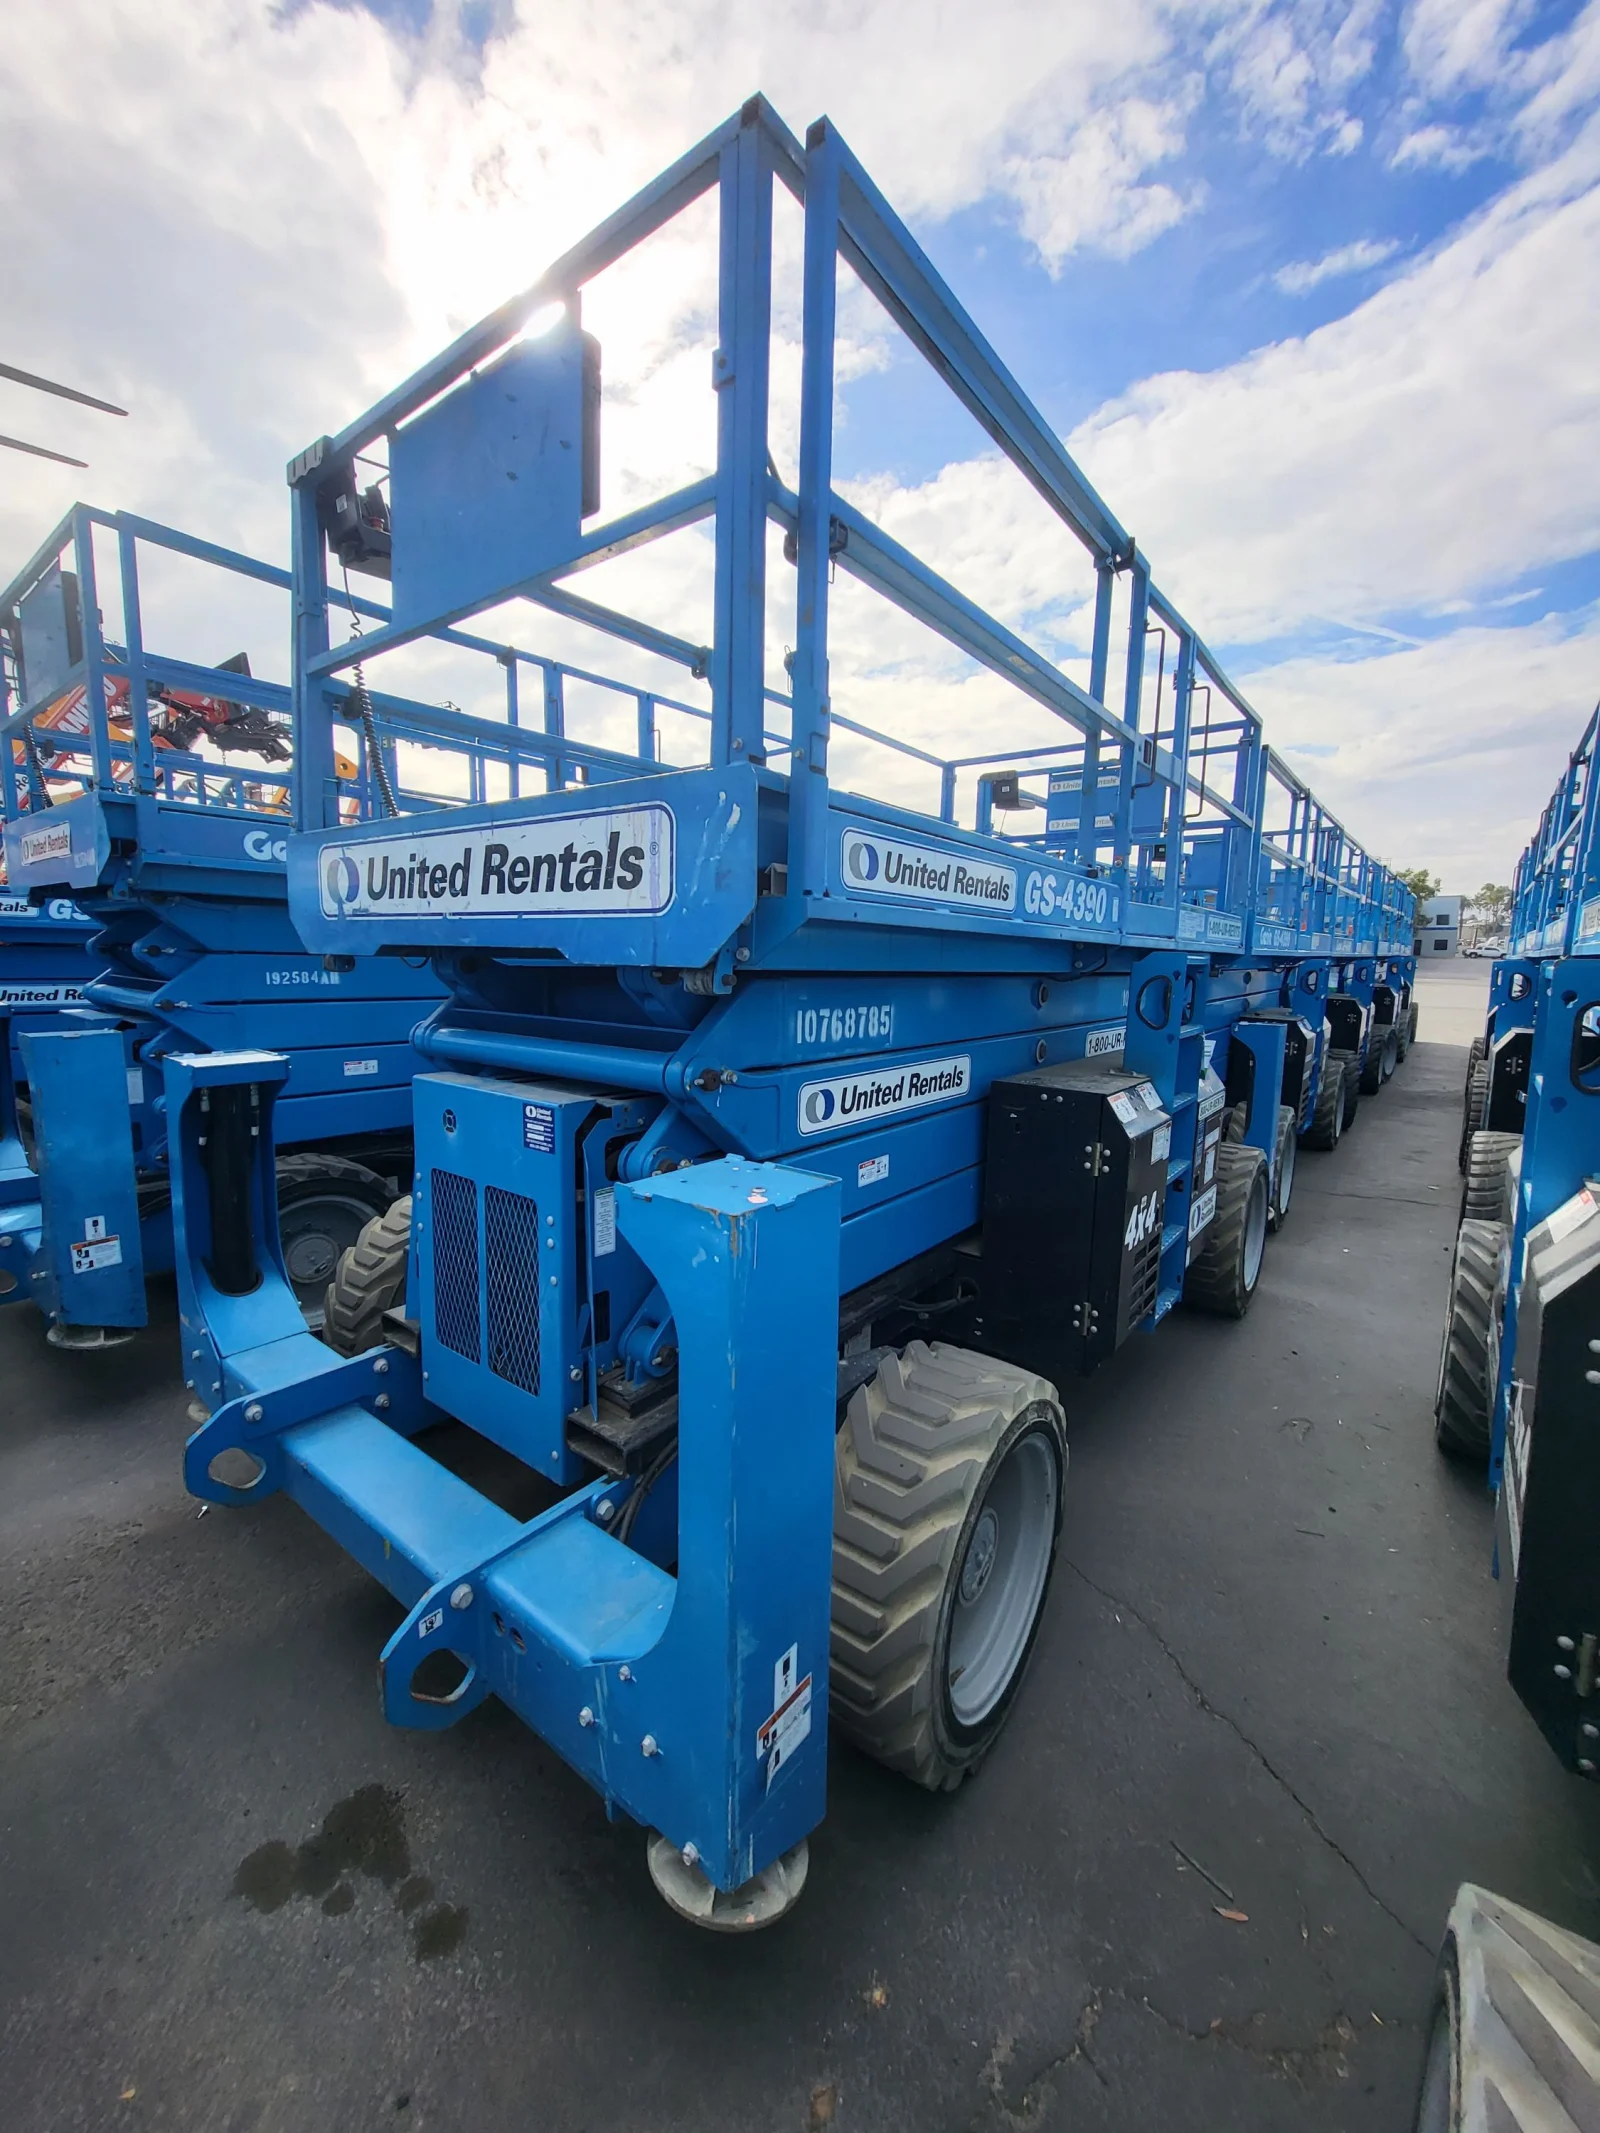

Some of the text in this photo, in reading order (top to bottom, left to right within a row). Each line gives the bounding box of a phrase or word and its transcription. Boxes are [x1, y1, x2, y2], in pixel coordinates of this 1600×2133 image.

[30, 829, 68, 857] United Rentals
[367, 831, 645, 901] United Rentals
[884, 850, 1010, 902] United Rentals
[1024, 870, 1107, 924] GS-4390
[796, 1005, 890, 1044] 10768785
[840, 1065, 964, 1115] United Rentals
